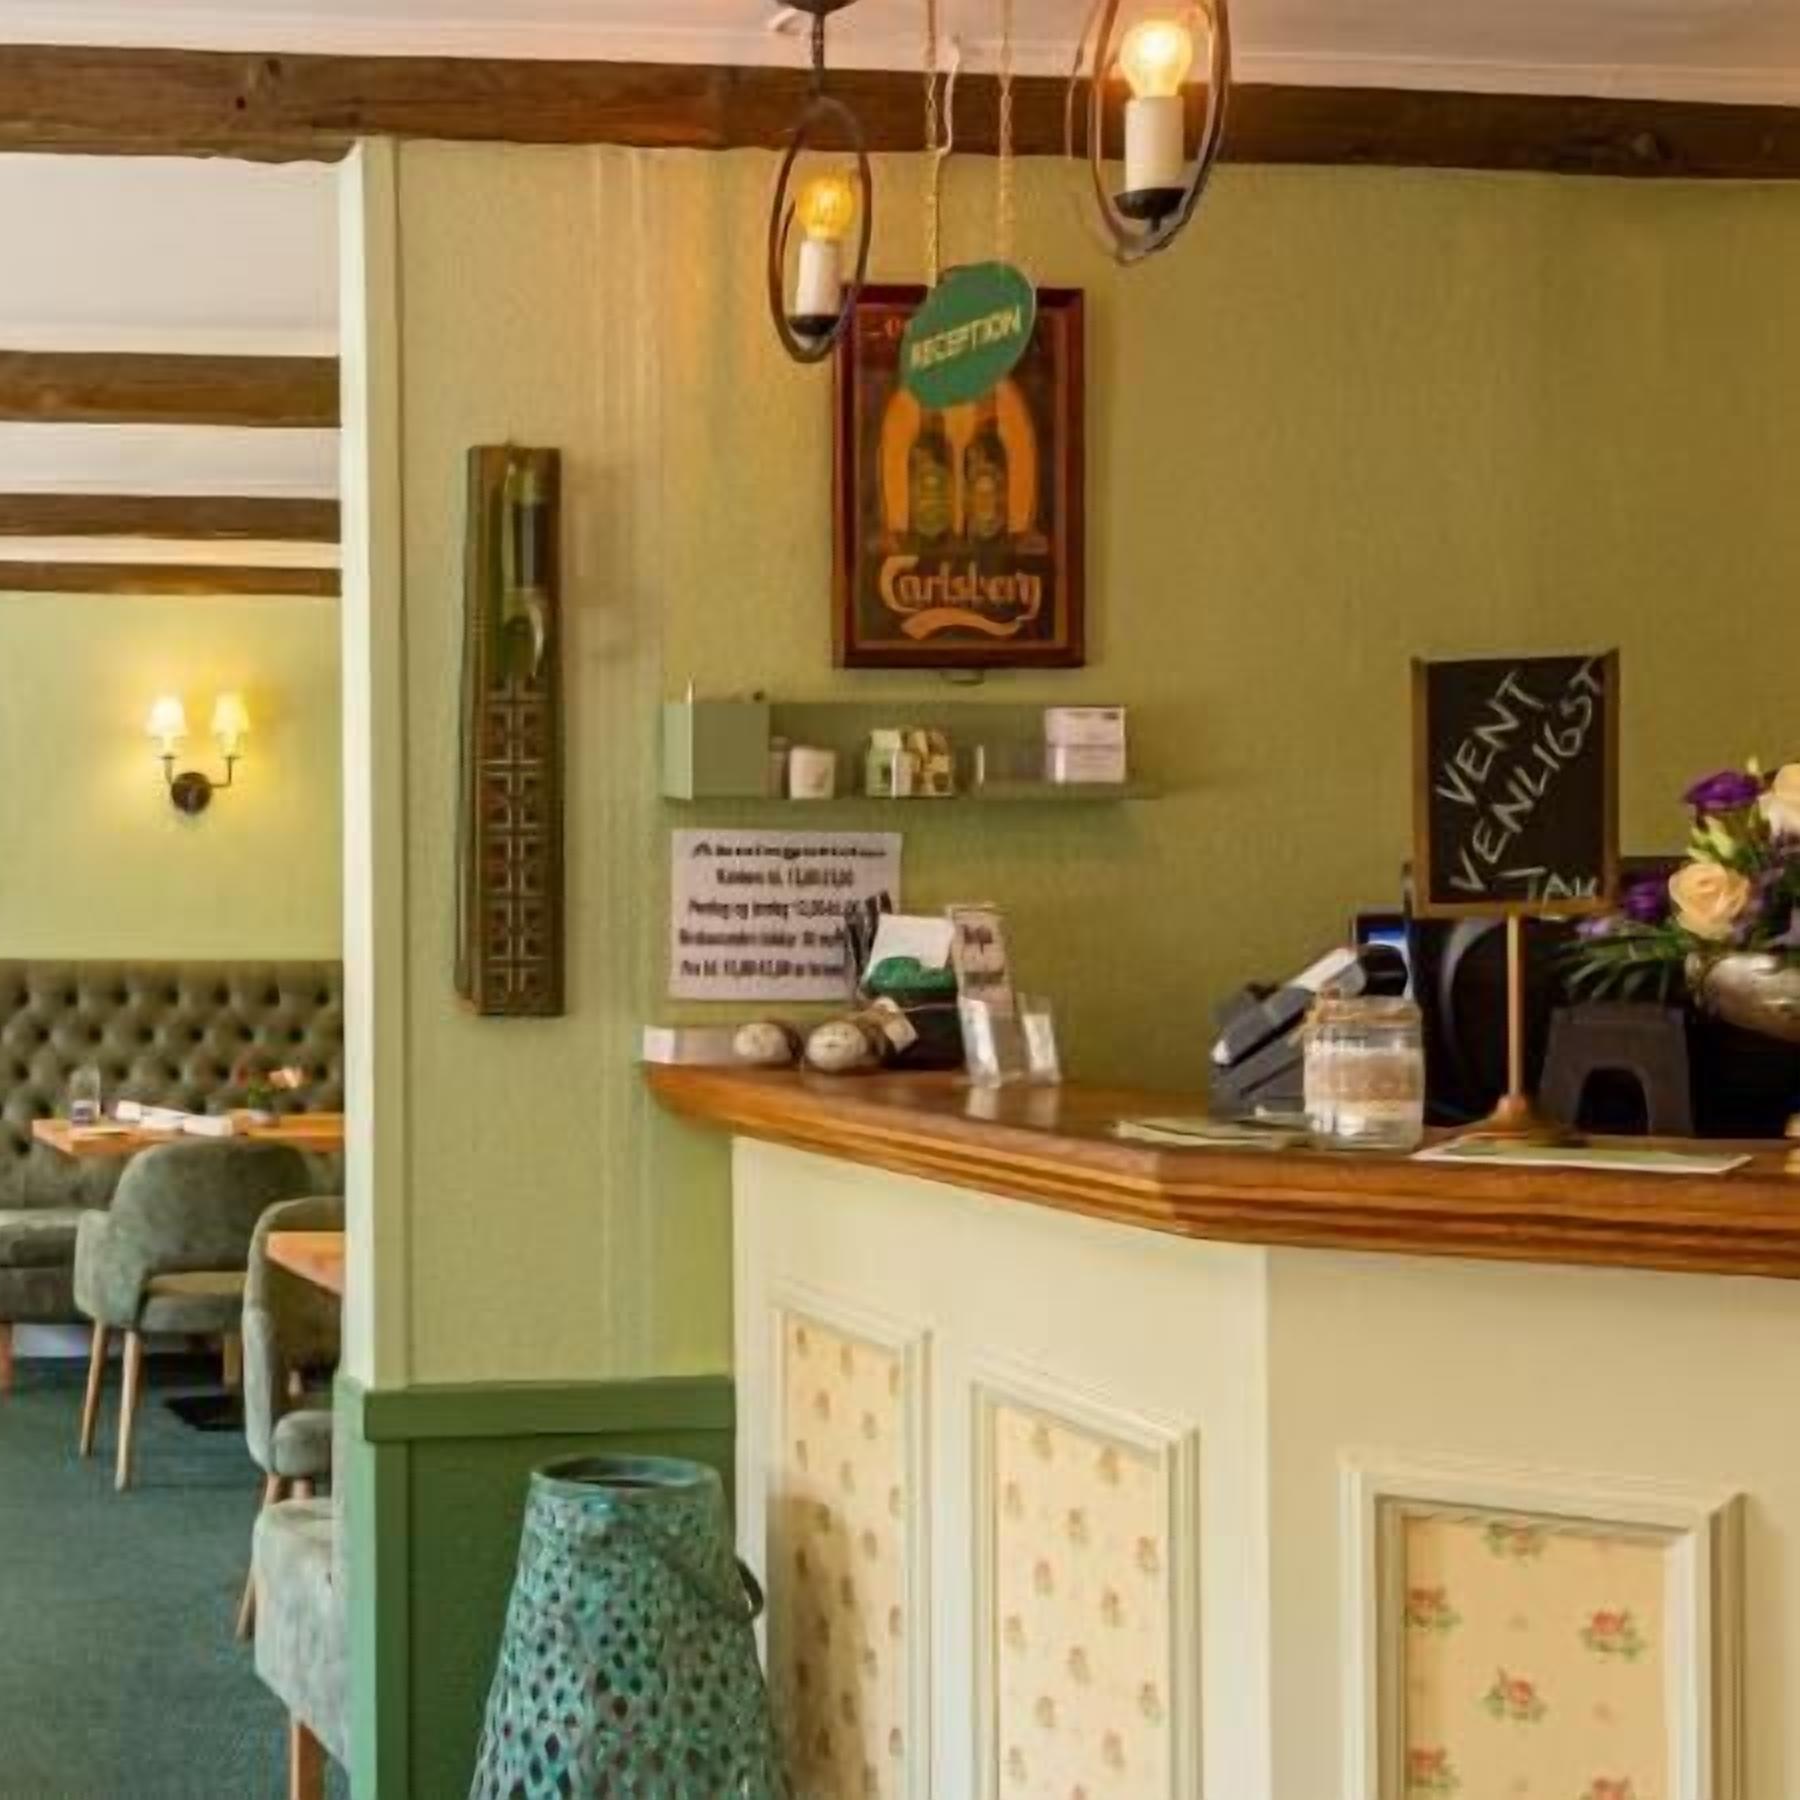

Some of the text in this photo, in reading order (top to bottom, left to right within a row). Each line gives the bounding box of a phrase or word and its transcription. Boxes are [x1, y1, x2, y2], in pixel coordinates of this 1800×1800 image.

[910, 306, 1022, 371] RECEPTION
[880, 554, 1042, 638] Carlsberg
[1435, 670, 1546, 804] VENT
[1449, 656, 1601, 892] VENLIGST
